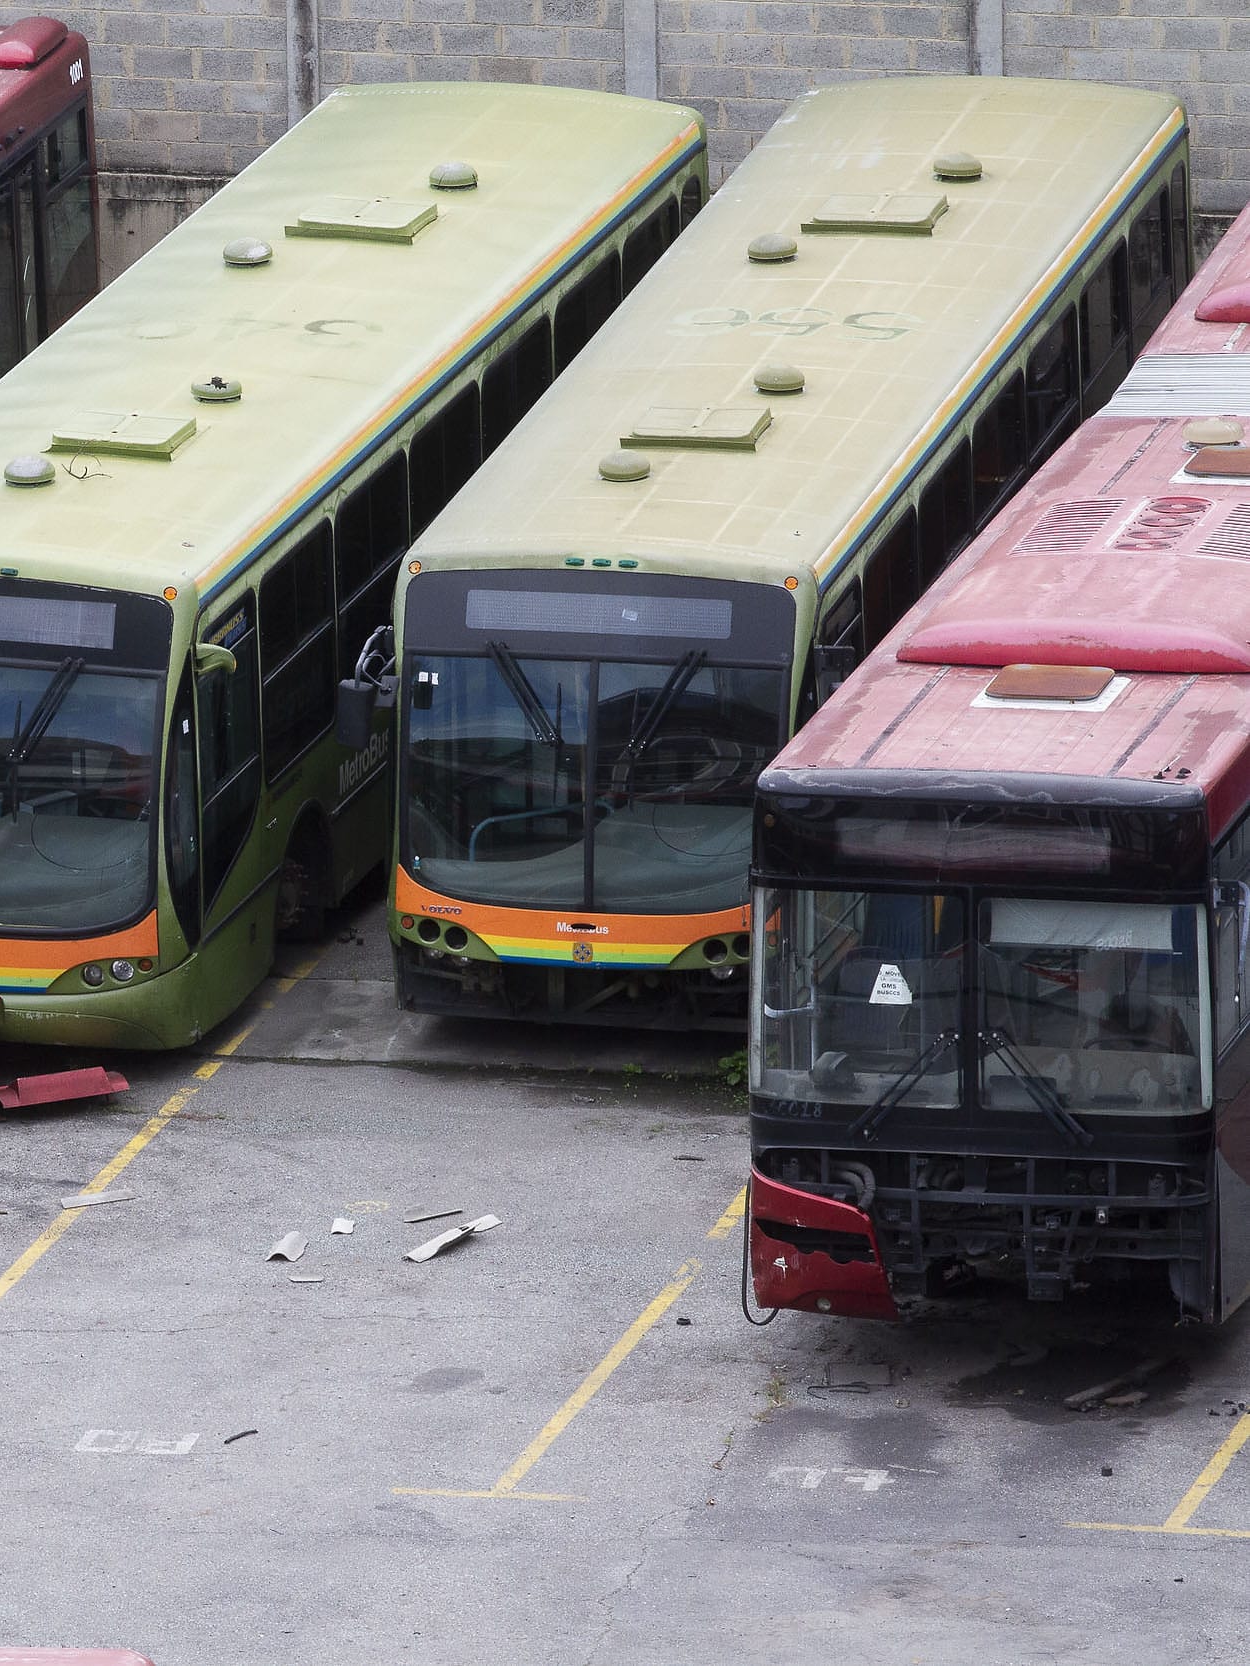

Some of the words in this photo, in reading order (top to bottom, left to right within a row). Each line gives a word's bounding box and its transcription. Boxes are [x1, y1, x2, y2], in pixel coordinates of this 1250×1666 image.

[70, 58, 83, 86] 1001
[421, 904, 462, 915] VOLVO
[557, 922, 609, 935] Meus
